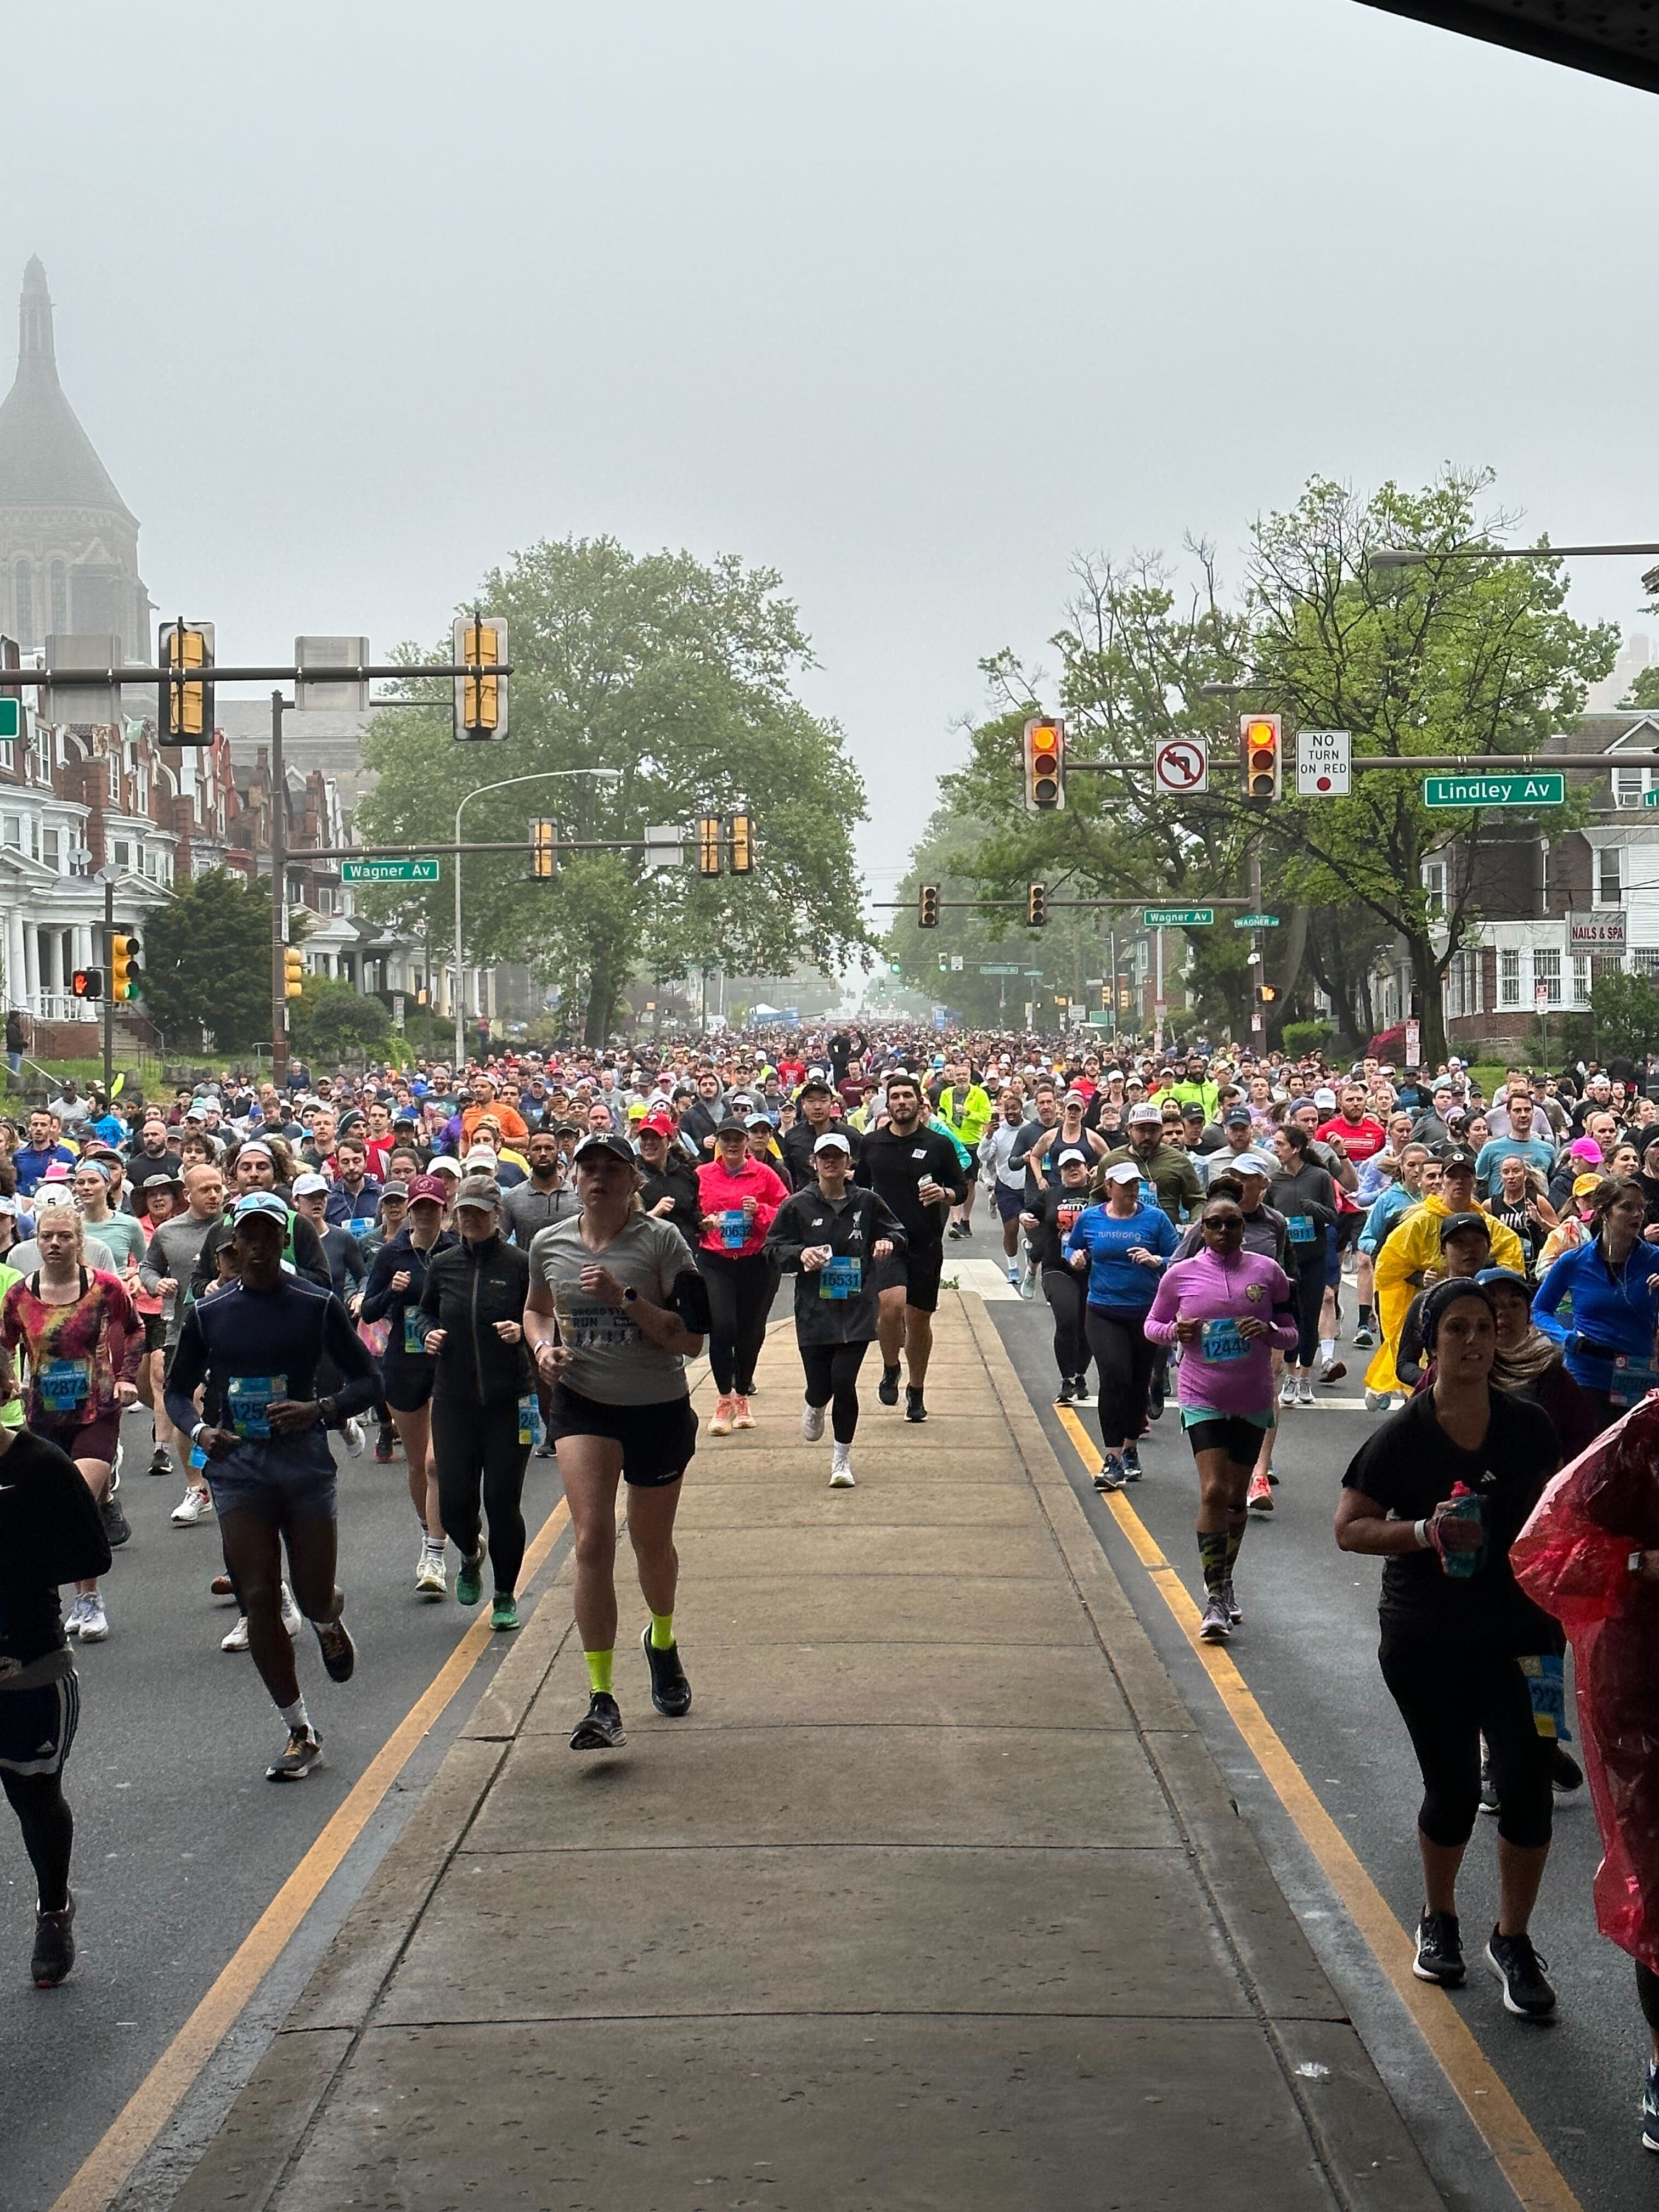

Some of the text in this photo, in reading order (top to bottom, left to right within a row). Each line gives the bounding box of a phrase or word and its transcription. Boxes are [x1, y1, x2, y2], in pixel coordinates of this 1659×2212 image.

[1313, 735, 1334, 747] NO
[1308, 750, 1339, 760] TURN
[1300, 763, 1346, 774] ON RED
[1438, 781, 1550, 801] Lindley Av
[1645, 794, 1659, 806] LI
[350, 865, 430, 879] Wagner Av
[1150, 912, 1207, 923] Wagner Av
[1572, 927, 1623, 940] NAILS & SPA
[1098, 1231, 1142, 1242] runstrong
[573, 1317, 597, 1327] RUN
[43, 1378, 88, 1397] 12874
